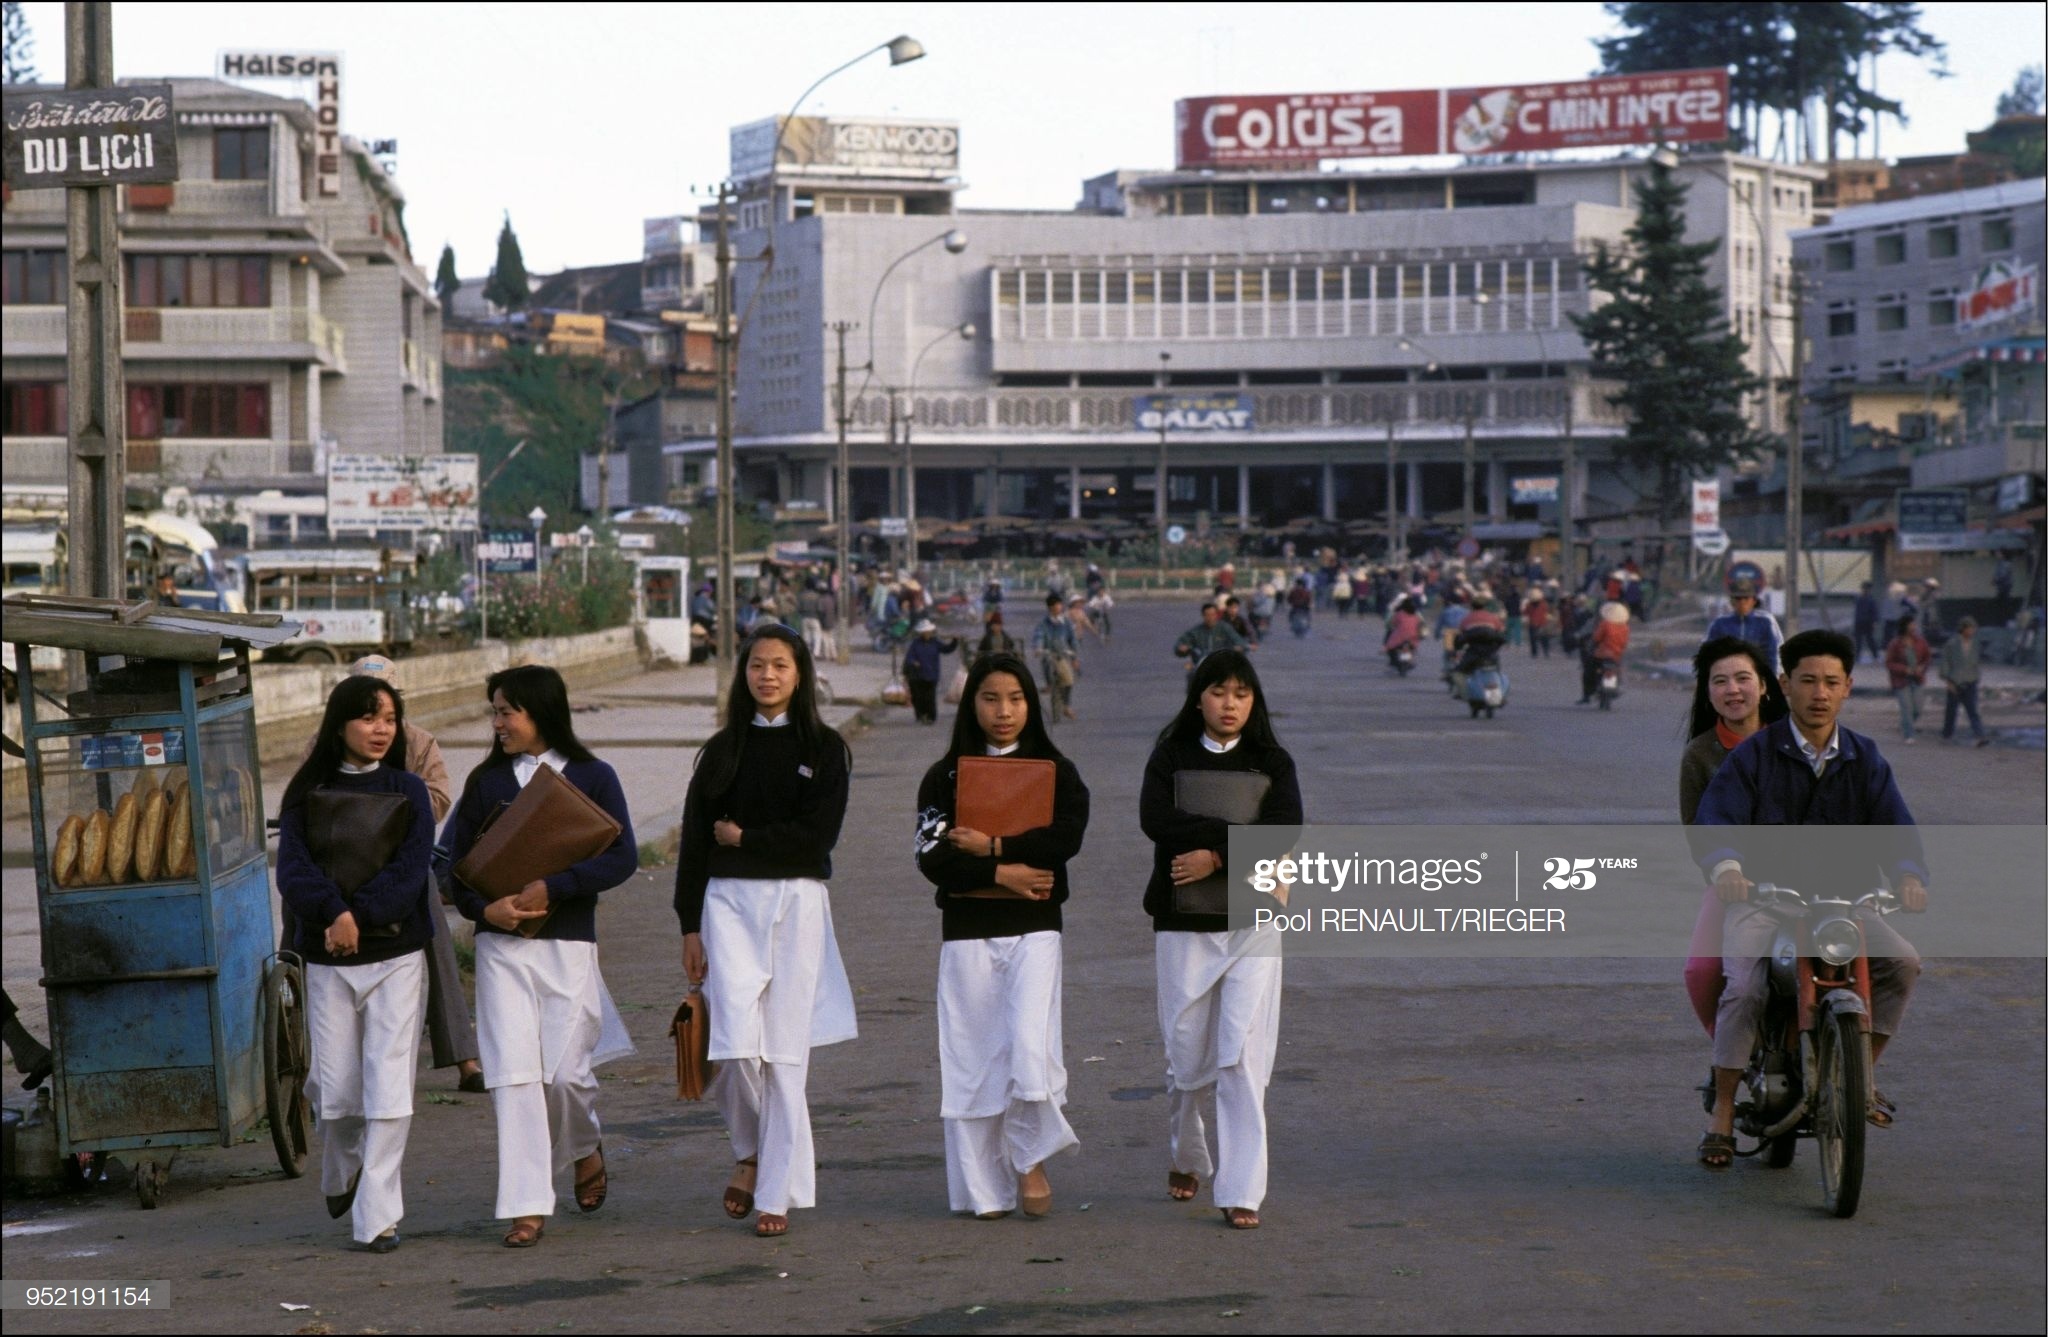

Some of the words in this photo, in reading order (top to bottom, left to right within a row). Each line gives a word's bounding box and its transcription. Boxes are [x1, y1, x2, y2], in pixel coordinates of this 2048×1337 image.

[23, 137, 68, 174] DU
[79, 132, 154, 176] LỊCH
[318, 80, 339, 197] HOTEL
[833, 125, 957, 154] KENWOOD
